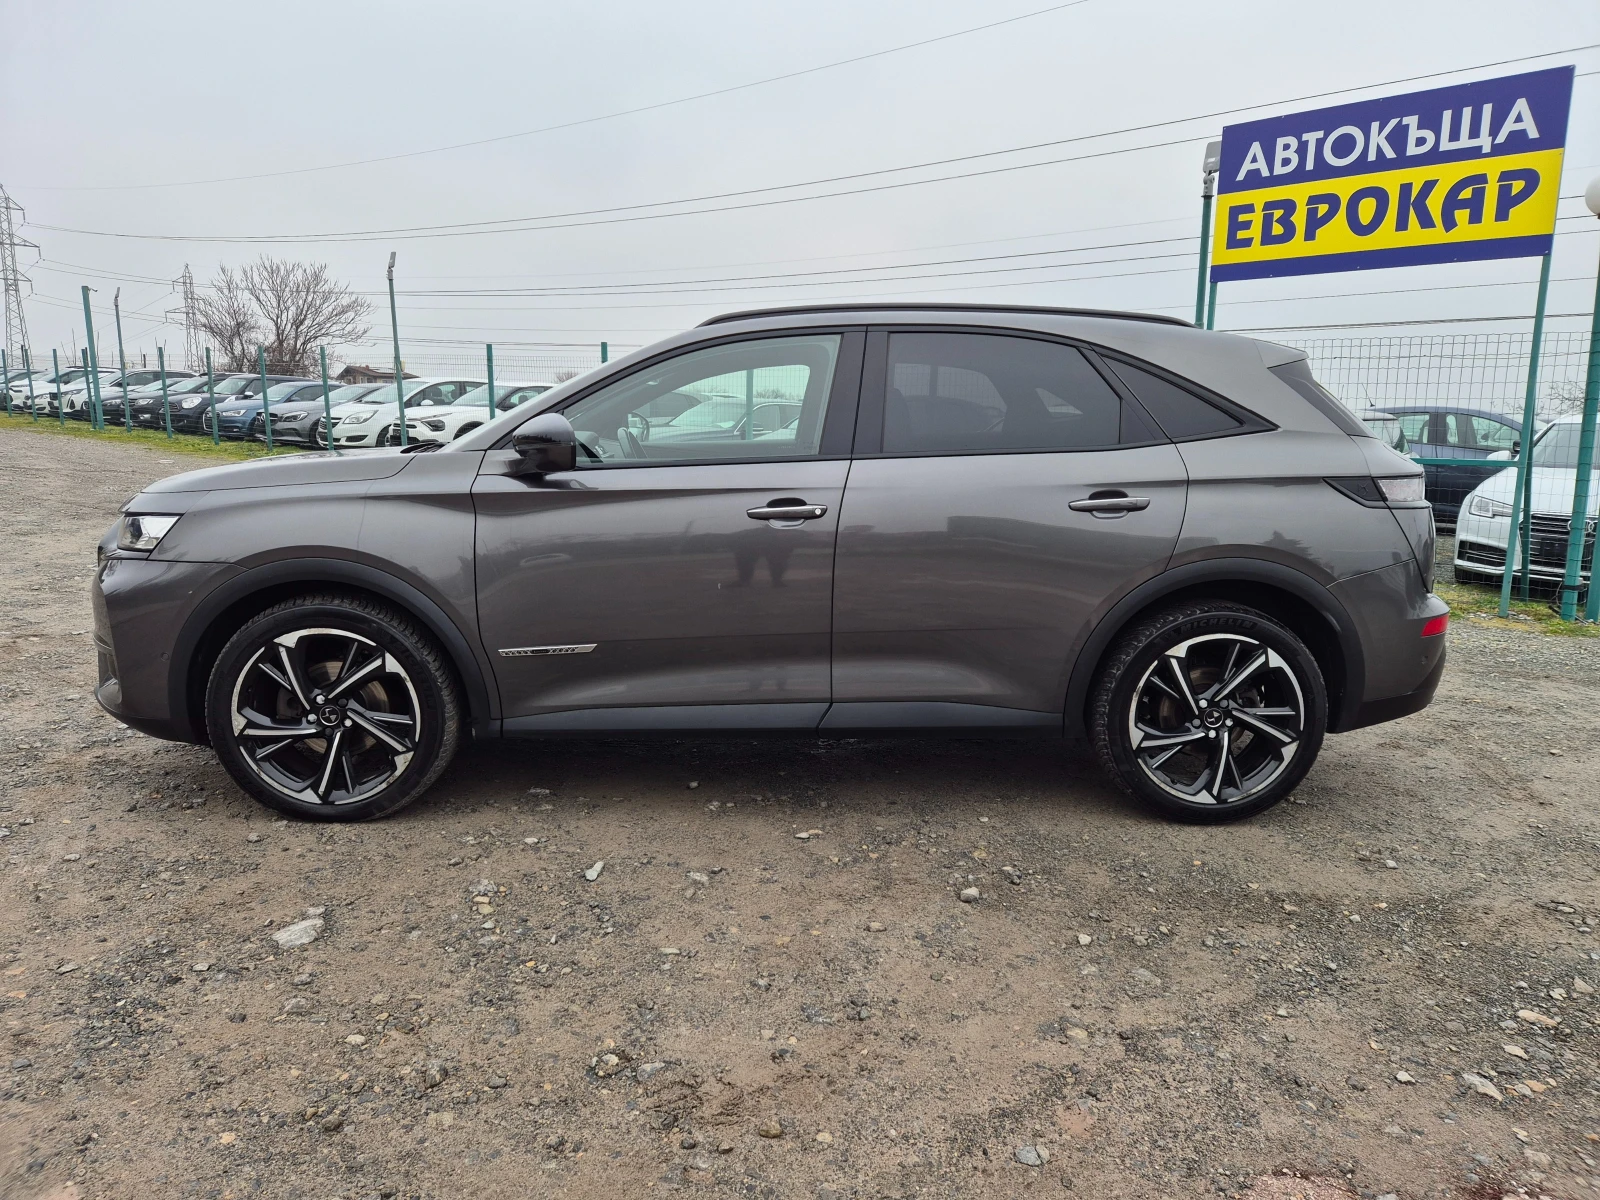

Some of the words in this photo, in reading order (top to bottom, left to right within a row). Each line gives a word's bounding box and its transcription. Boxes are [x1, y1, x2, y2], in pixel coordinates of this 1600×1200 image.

[1236, 97, 1540, 181] АВТОКЪЩА
[1225, 167, 1541, 250] ЕВРОКАР
[1181, 617, 1255, 632] MICHELIN
